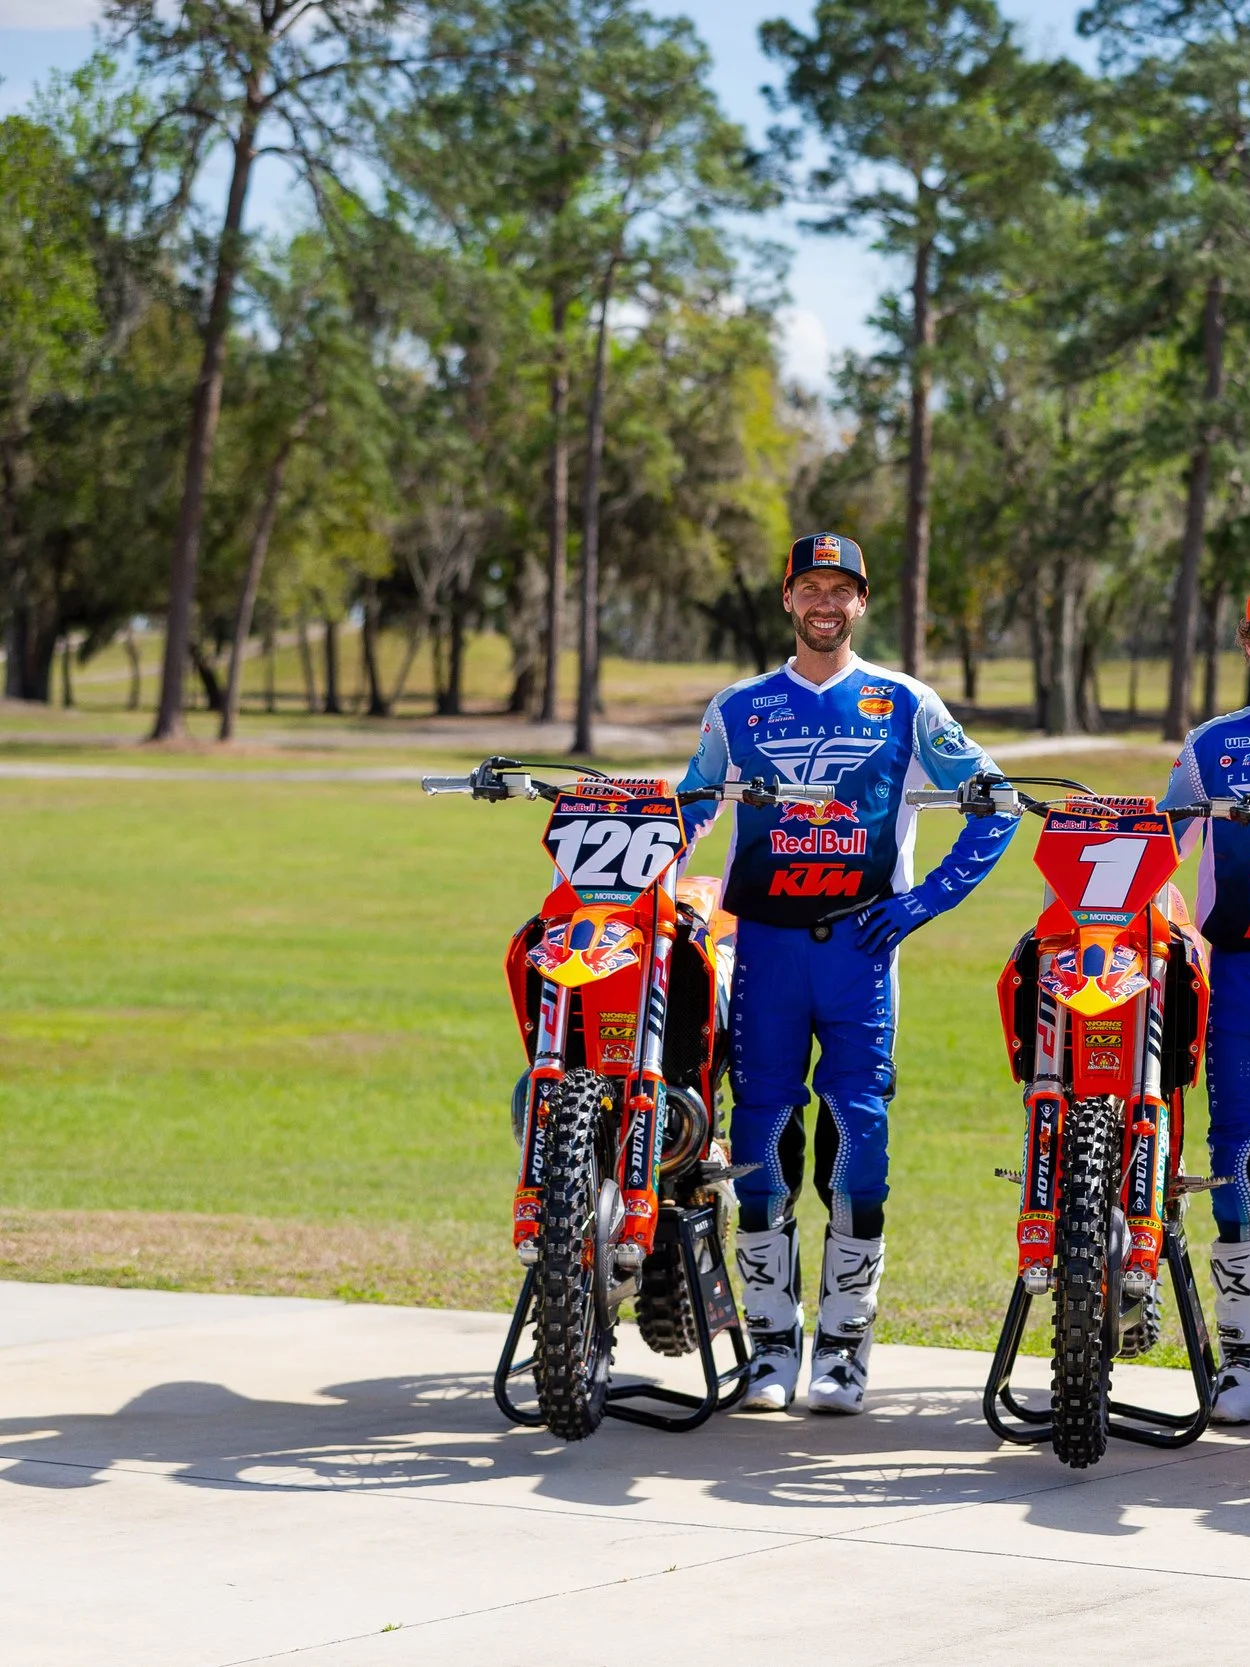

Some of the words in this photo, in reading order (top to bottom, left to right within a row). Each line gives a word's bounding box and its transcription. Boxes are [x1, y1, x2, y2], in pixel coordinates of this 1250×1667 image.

[752, 694, 788, 709] WPS
[861, 686, 894, 696] MRC
[753, 728, 788, 742] FLY
[801, 725, 888, 738] RACING
[561, 803, 578, 812] Red
[578, 803, 596, 812] Bull
[641, 804, 672, 815] KTM
[1051, 820, 1069, 829] Red
[1069, 820, 1087, 830] Bull
[1133, 821, 1163, 832] KTM
[770, 828, 817, 854] Red
[819, 828, 867, 855] Bull
[548, 820, 680, 888] 126
[768, 863, 863, 896] KTM
[1078, 837, 1149, 909] 1
[594, 893, 632, 901] MOTOREX
[899, 894, 927, 917] FLY
[1089, 914, 1127, 922] MOTOREX
[653, 1088, 667, 1163] MOTOREX
[1155, 1109, 1169, 1191] MOTOREX
[1036, 1120, 1052, 1206] DNLOP
